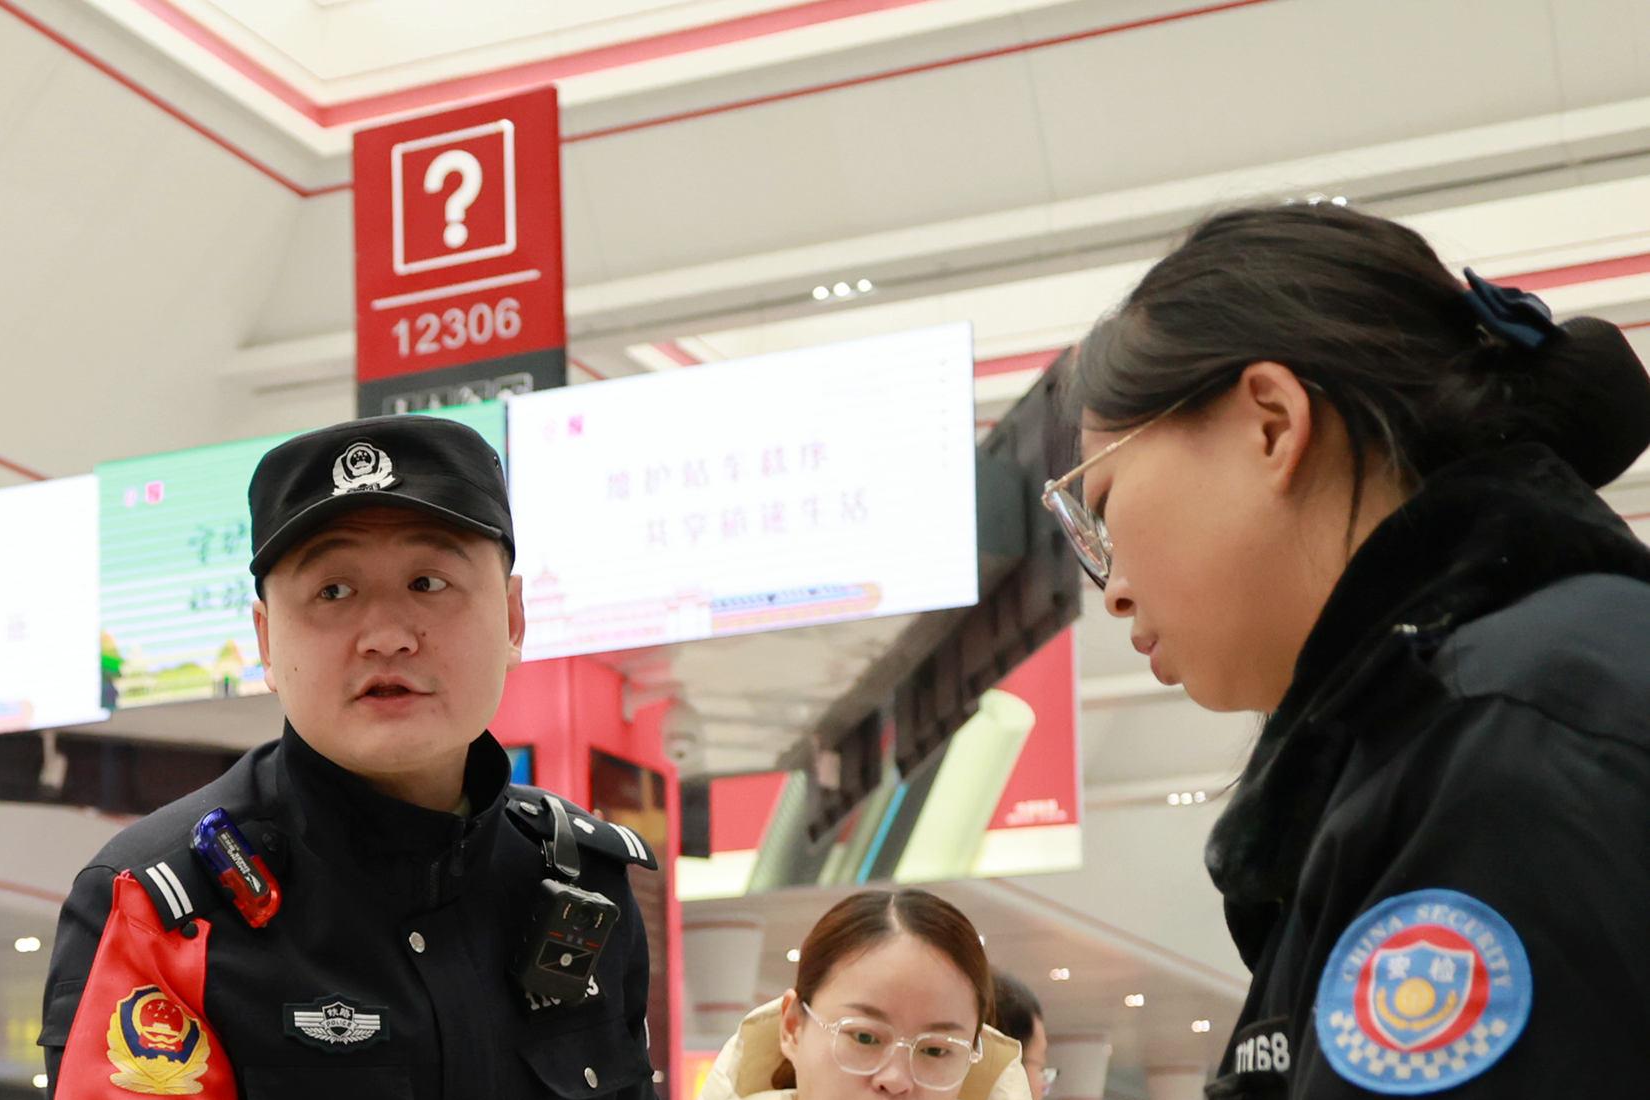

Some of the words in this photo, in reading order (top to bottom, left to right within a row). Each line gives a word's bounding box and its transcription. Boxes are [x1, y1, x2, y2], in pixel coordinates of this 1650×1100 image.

[392, 298, 522, 357] 12306
[1343, 915, 1404, 983] CHINA
[1415, 904, 1513, 987] SECURITY
[325, 1019, 353, 1028] POLICE
[326, 1007, 351, 1019] 铁路
